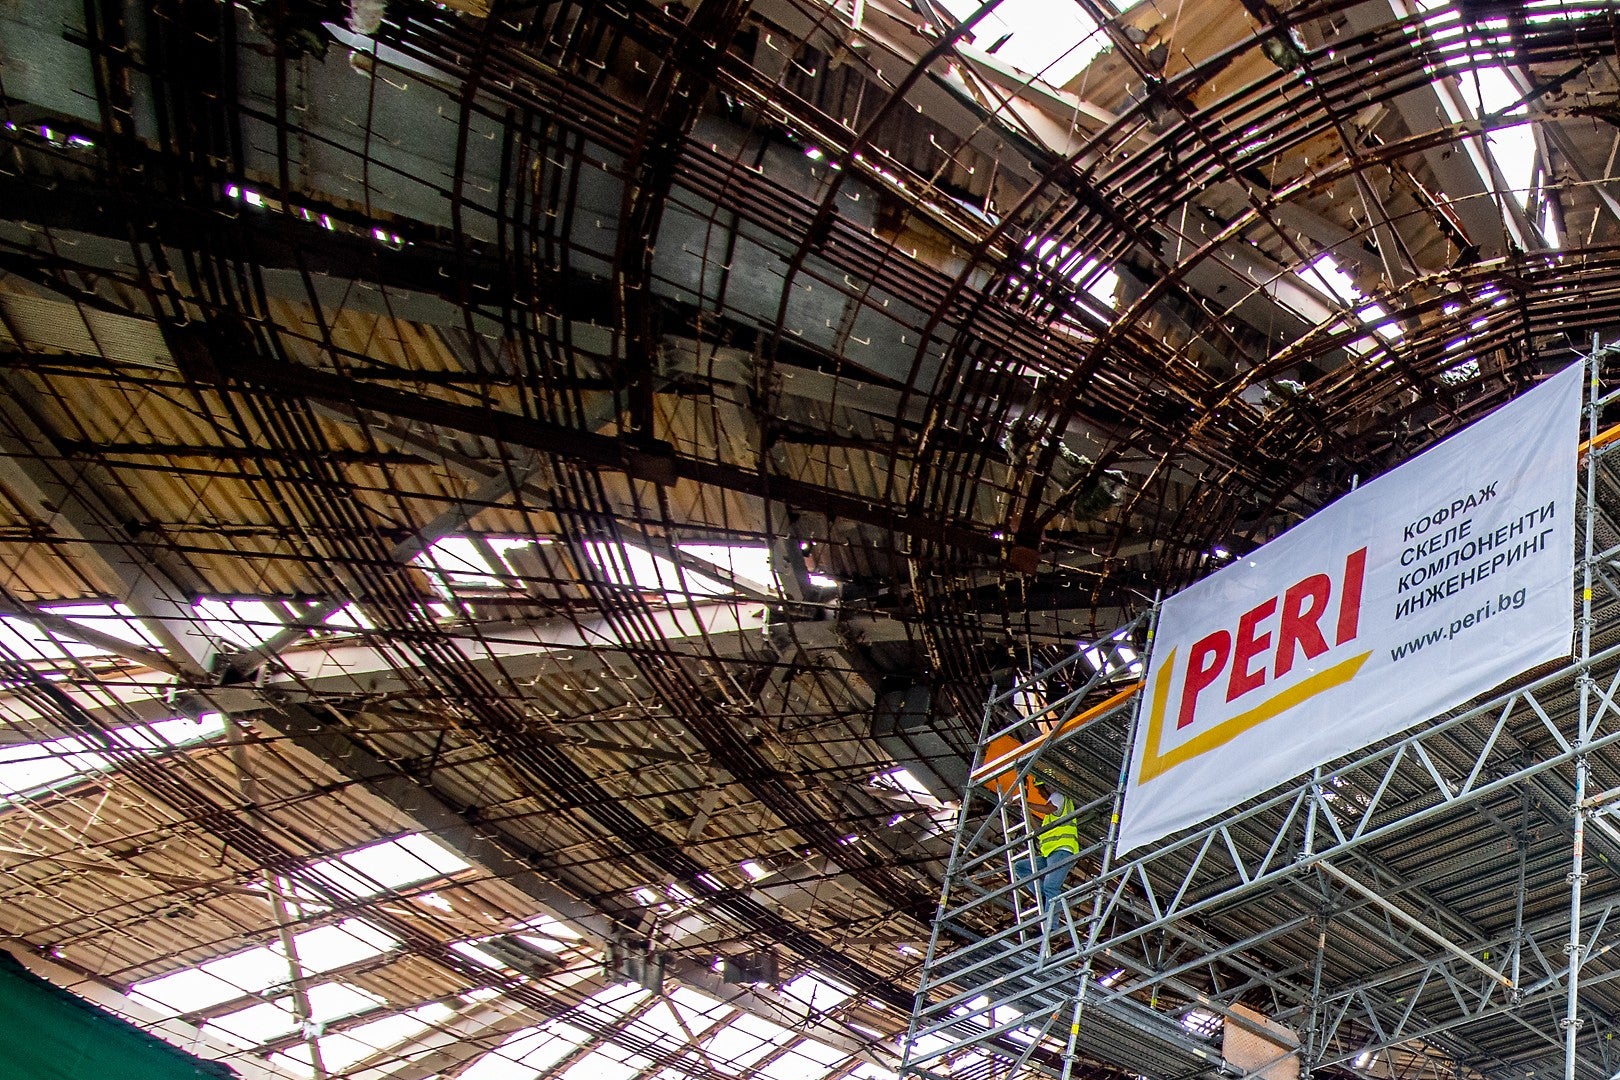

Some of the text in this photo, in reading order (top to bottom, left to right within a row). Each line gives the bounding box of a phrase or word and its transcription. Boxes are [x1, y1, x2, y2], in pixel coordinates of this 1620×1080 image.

[1397, 500, 1555, 594] КОМПОНЕНТИ
[1400, 518, 1473, 566] СКЕЛЕ
[1403, 480, 1498, 542] КОФРАЖ
[1395, 528, 1554, 620] ИНЖЕНЕРИНГ
[1176, 546, 1368, 731] PERI
[1390, 588, 1526, 662] www.peri.bg
